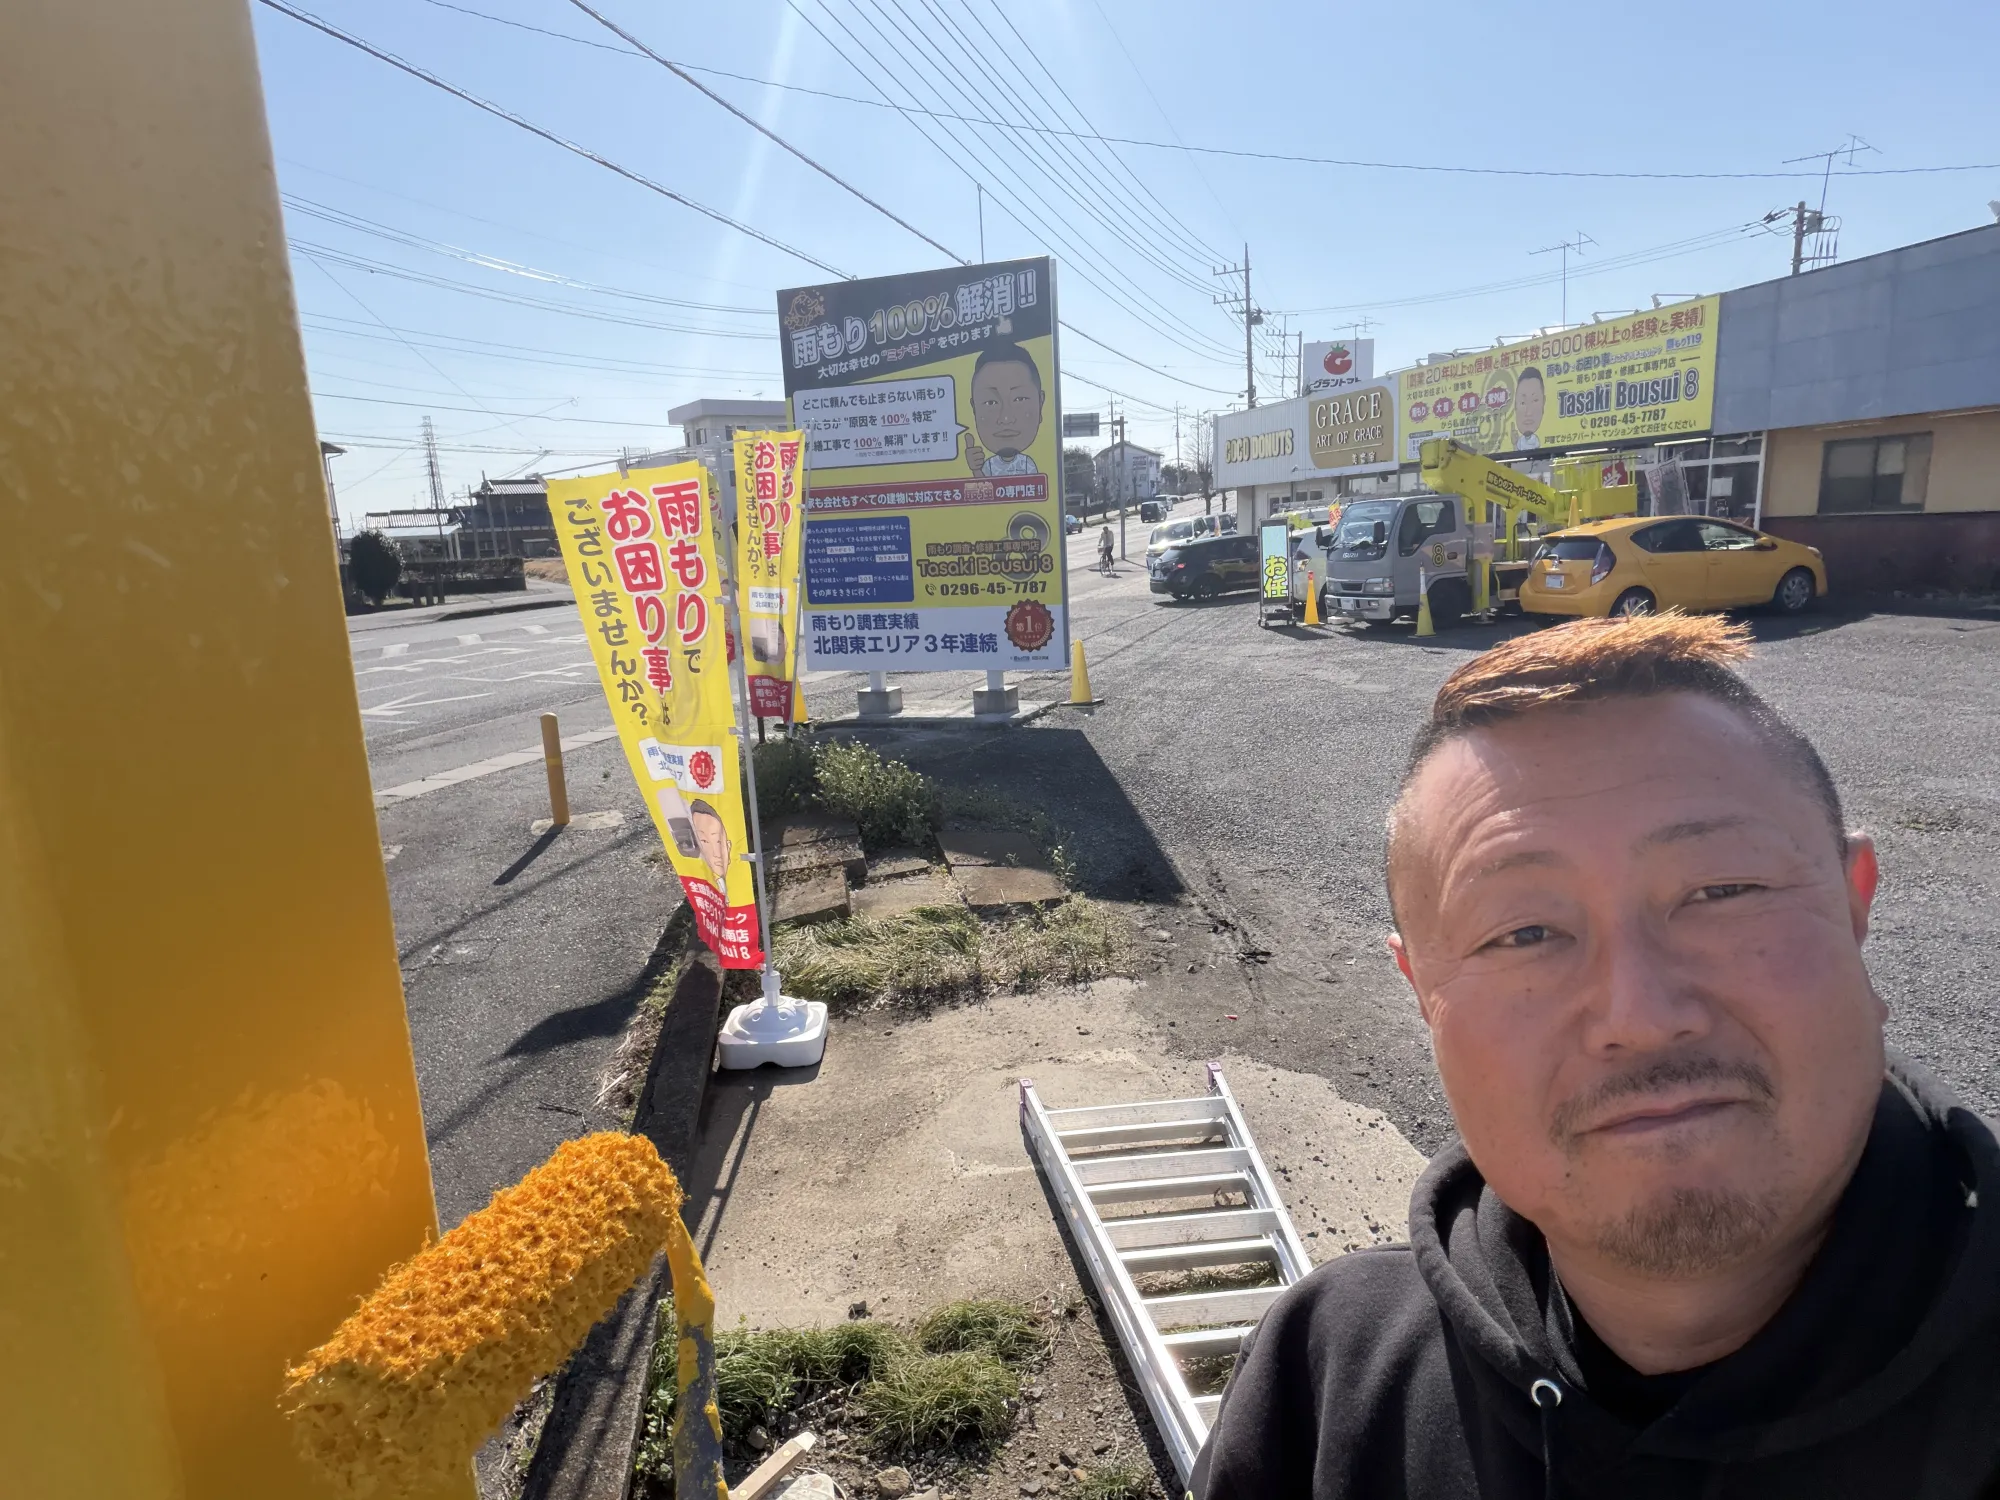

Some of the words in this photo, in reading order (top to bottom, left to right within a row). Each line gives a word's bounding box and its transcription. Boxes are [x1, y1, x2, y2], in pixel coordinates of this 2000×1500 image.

[802, 387, 946, 411] どこに頼んでも止まらない雨もり
[1557, 383, 1612, 418] Tasaki
[1615, 372, 1681, 409] Bousui
[1683, 368, 1700, 399] 8
[1315, 391, 1382, 430] GRACE
[1590, 408, 1666, 429] 0296-45-7787
[1251, 428, 1294, 460] DONUTS
[1316, 433, 1332, 449] ART
[1337, 431, 1349, 444] OF
[1353, 424, 1382, 441] GRACE
[754, 441, 781, 577] お困り事は
[652, 480, 708, 674] 雨もりで
[917, 557, 975, 578] Tasaki
[978, 555, 1038, 576] Bousui
[1040, 555, 1053, 574] 8
[940, 582, 1047, 597] 0296-45-7787
[812, 614, 920, 631] 雨もり調査実績
[740, 946, 751, 960] 8
